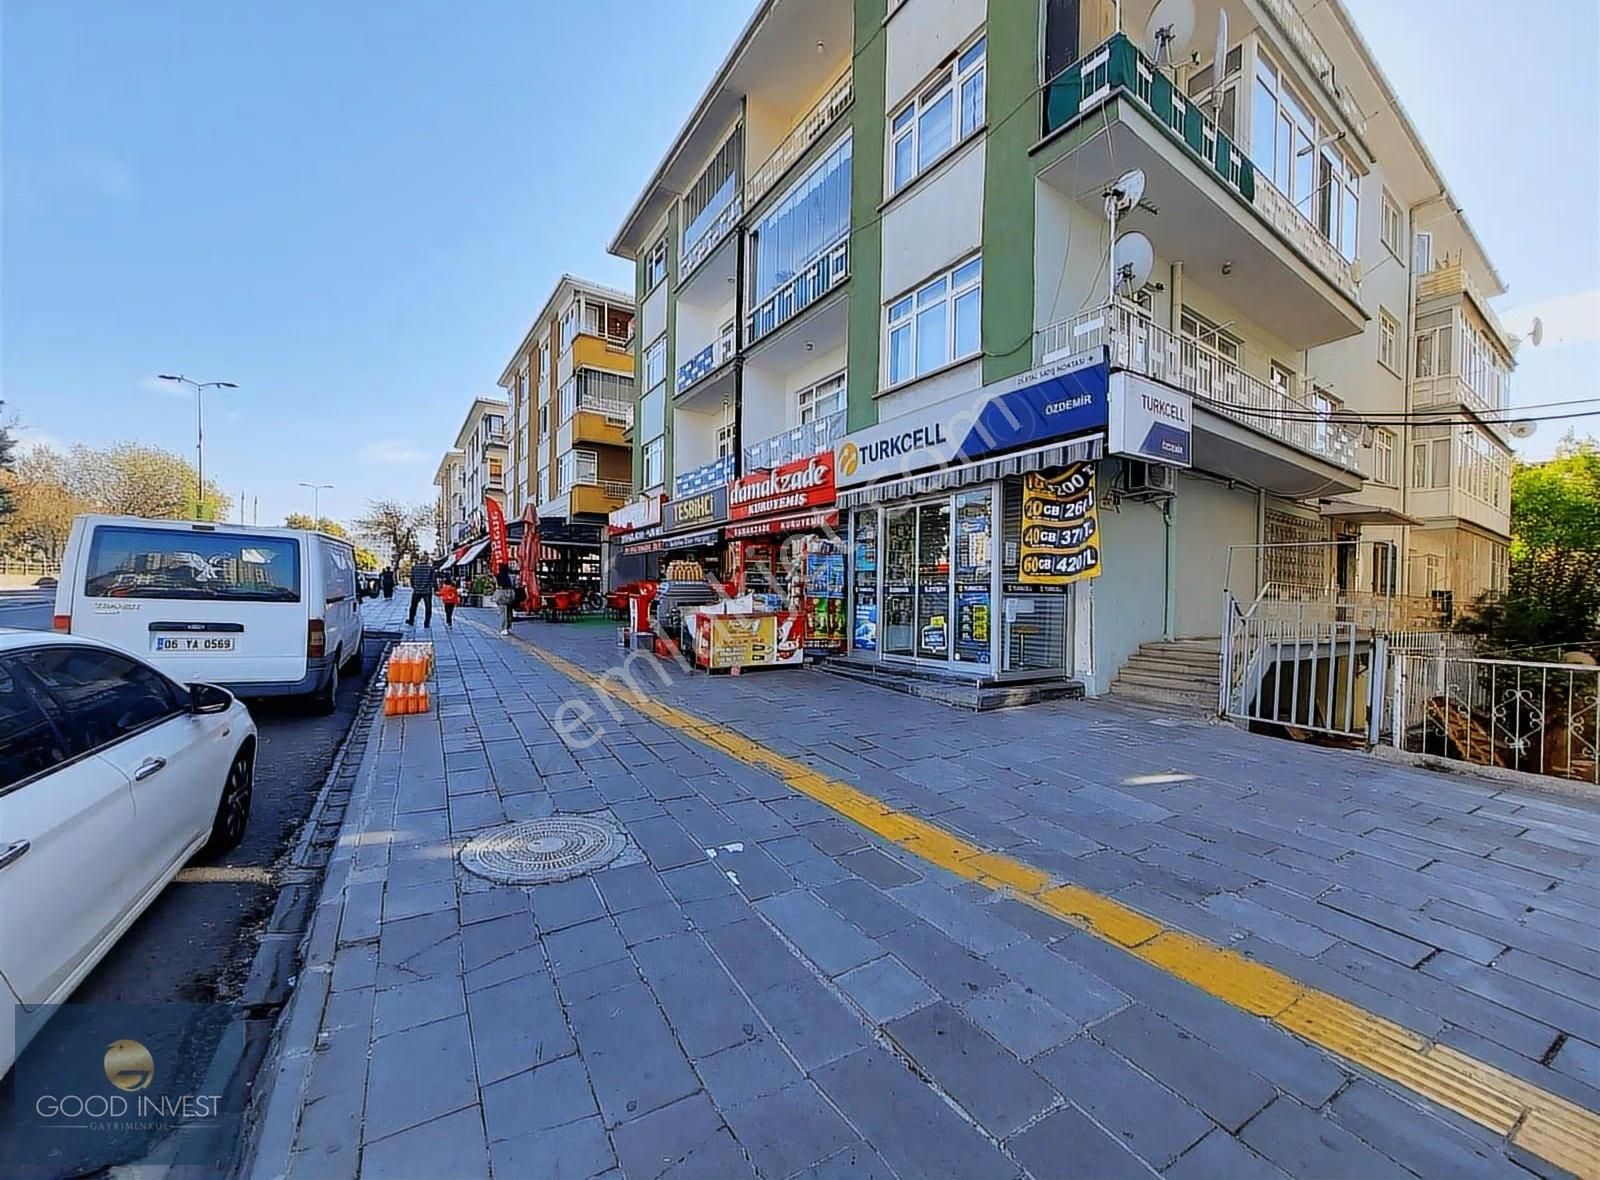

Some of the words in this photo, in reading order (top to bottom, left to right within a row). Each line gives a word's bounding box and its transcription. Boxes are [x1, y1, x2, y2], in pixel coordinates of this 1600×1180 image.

[1141, 394, 1185, 422] TURKCELL
[859, 423, 947, 465] TURKCELL
[730, 457, 829, 505] damakzade
[164, 638, 178, 649] 06
[187, 638, 198, 649] YA
[204, 638, 231, 649] 0569
